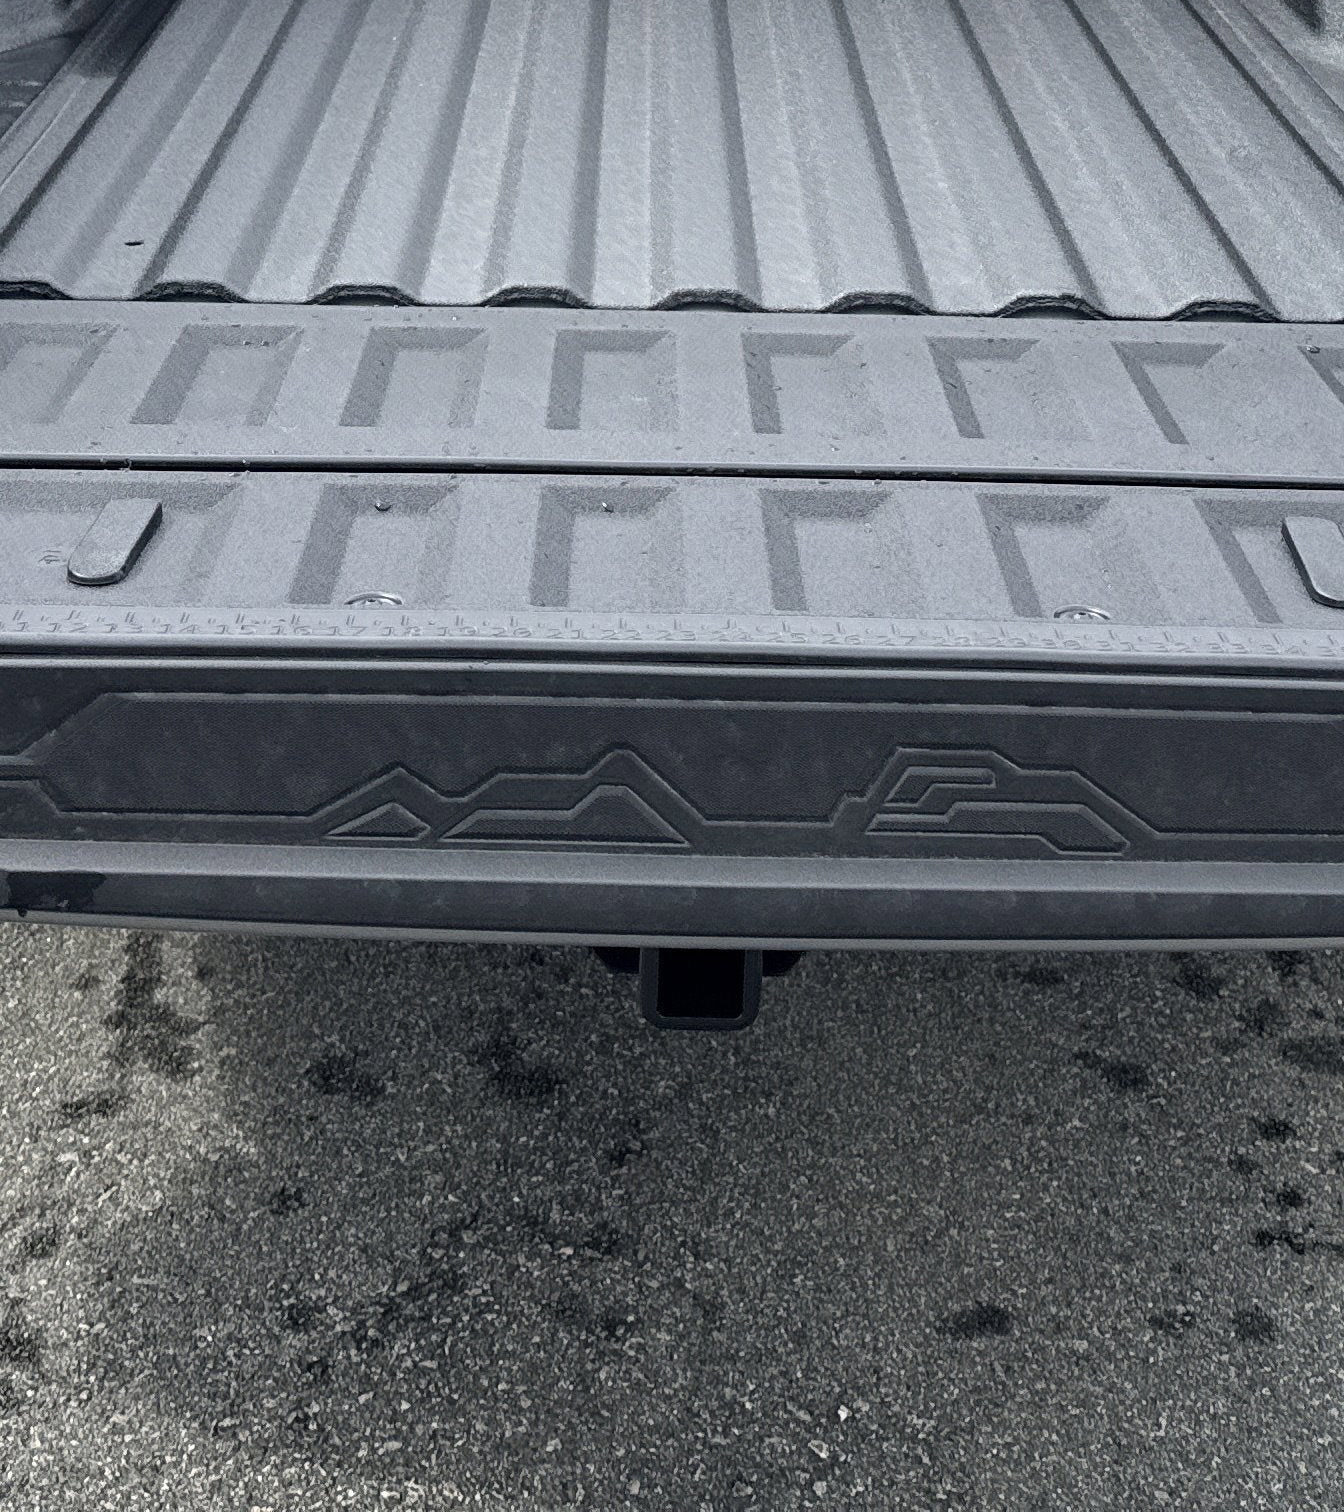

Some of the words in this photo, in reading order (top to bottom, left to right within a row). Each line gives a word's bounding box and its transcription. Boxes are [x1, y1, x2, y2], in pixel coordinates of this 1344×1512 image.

[157, 624, 202, 634] 14
[326, 625, 366, 636] 17
[547, 629, 585, 639] 21
[601, 630, 641, 640] 22
[876, 635, 917, 646] 27
